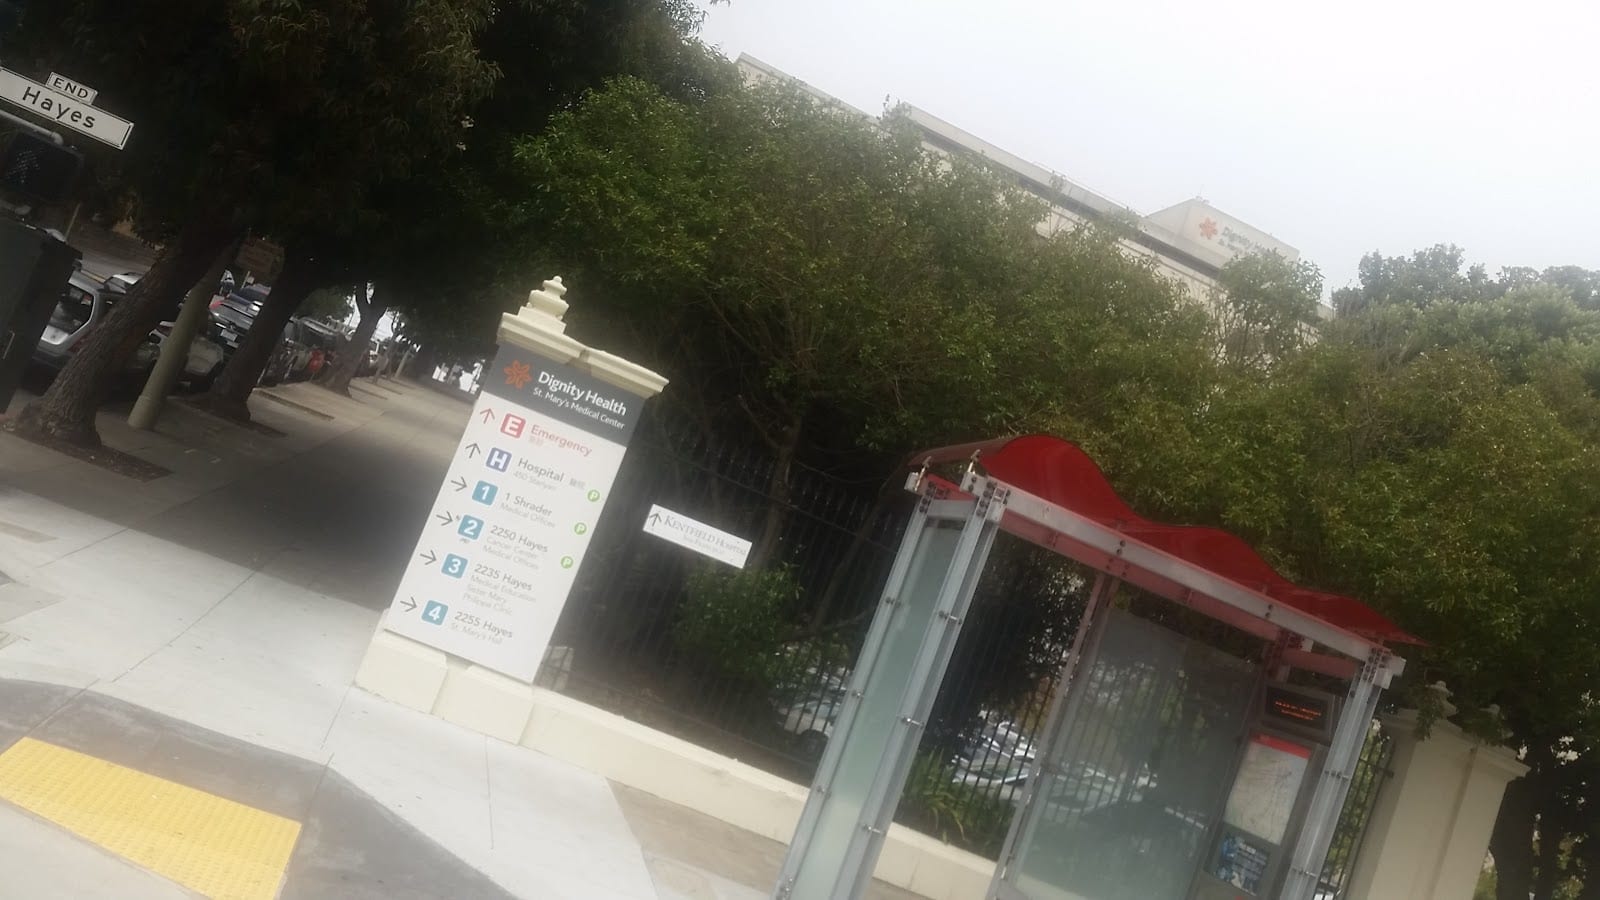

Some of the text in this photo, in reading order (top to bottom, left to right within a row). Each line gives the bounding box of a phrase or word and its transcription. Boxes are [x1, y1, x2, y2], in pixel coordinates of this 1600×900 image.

[52, 77, 89, 99] END
[22, 86, 96, 129] Hayes
[533, 387, 626, 429] St. Mary's Medical Center
[538, 370, 627, 416] Dignity Health
[504, 416, 523, 436] E
[531, 424, 593, 457] Emergency
[490, 450, 565, 482] H Hospital
[501, 502, 530, 519] Medical
[505, 492, 511, 501] 1
[514, 495, 552, 517] Shrader
[463, 519, 478, 536] 2
[490, 525, 517, 541] 2250
[518, 535, 548, 552] Hayes
[447, 557, 532, 591] 3 2235 Hayes
[428, 605, 513, 638] 4 2255 Hayes
